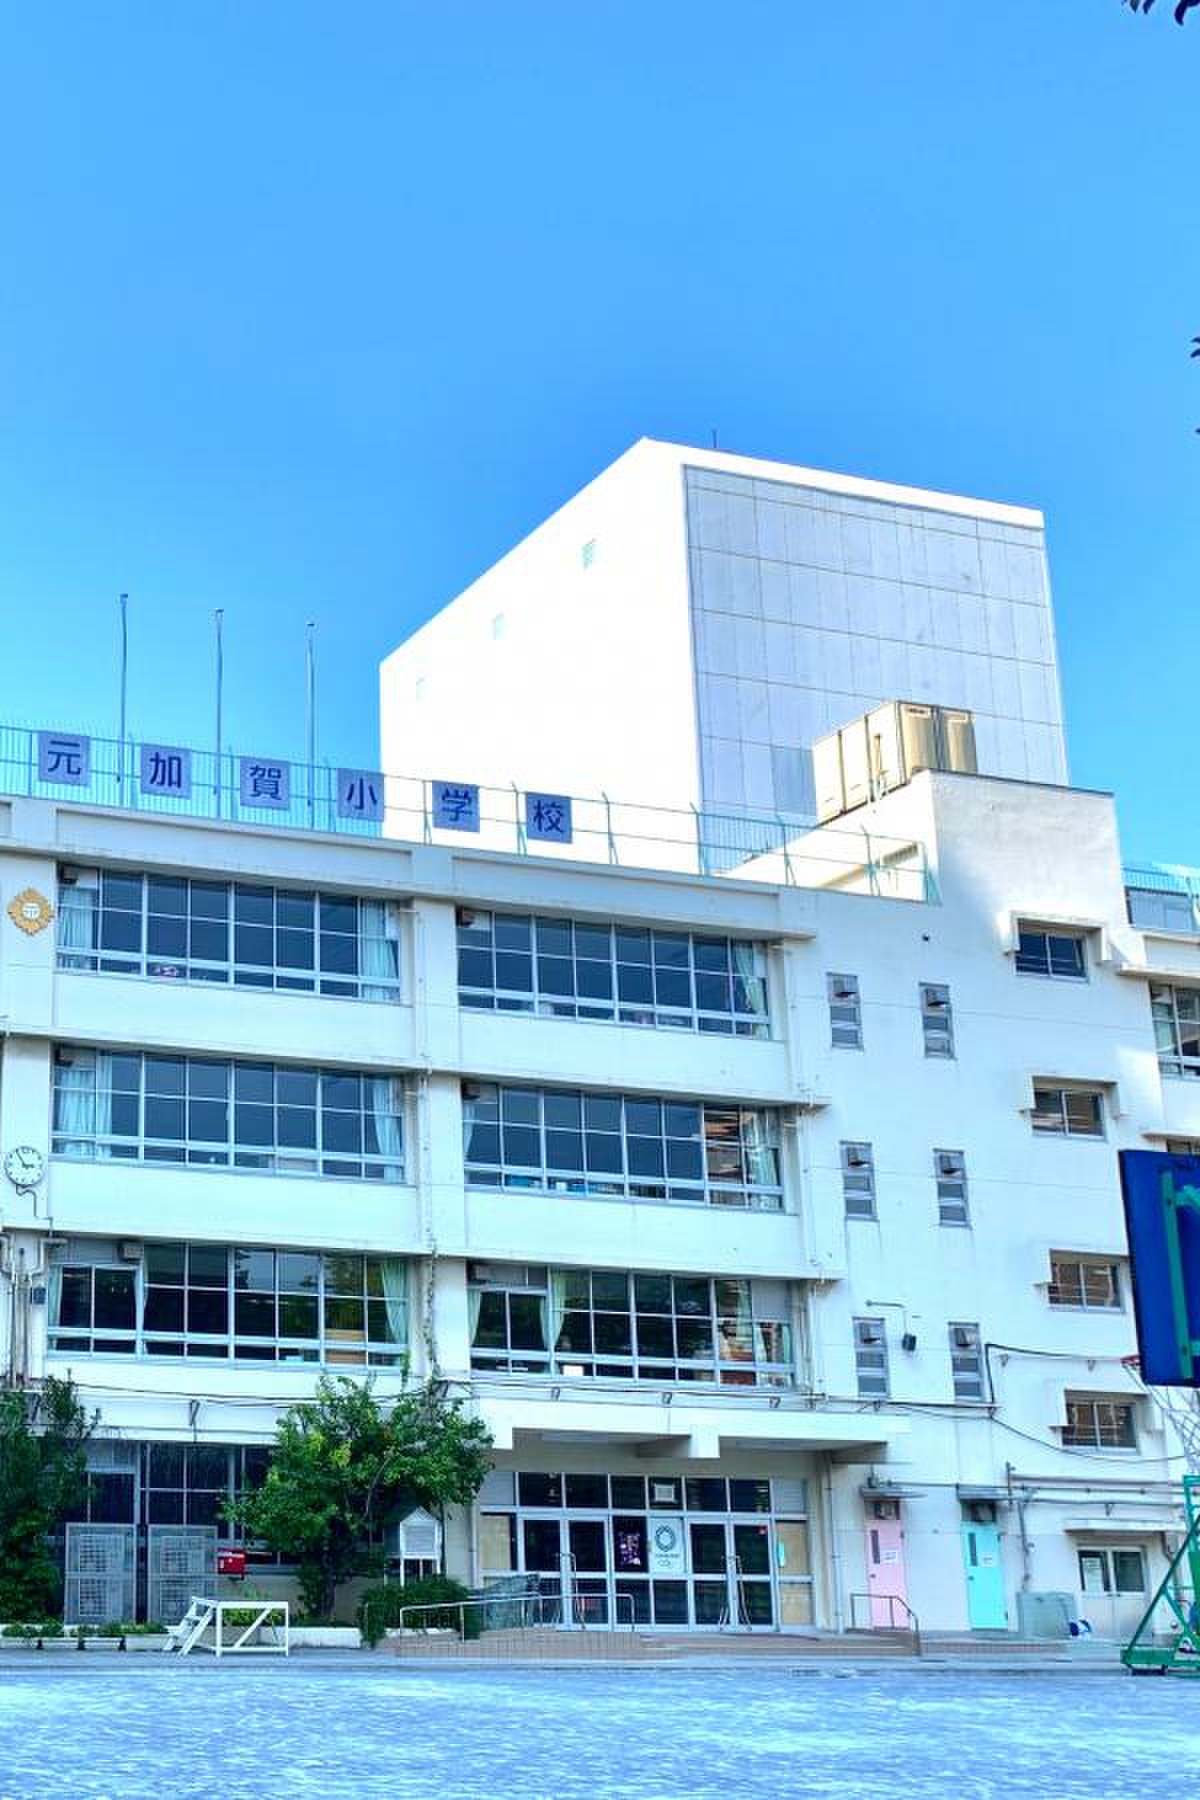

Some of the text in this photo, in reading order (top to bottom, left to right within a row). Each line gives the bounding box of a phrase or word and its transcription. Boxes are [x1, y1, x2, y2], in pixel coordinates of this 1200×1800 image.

[47, 740, 564, 834] 元加賀小学校
